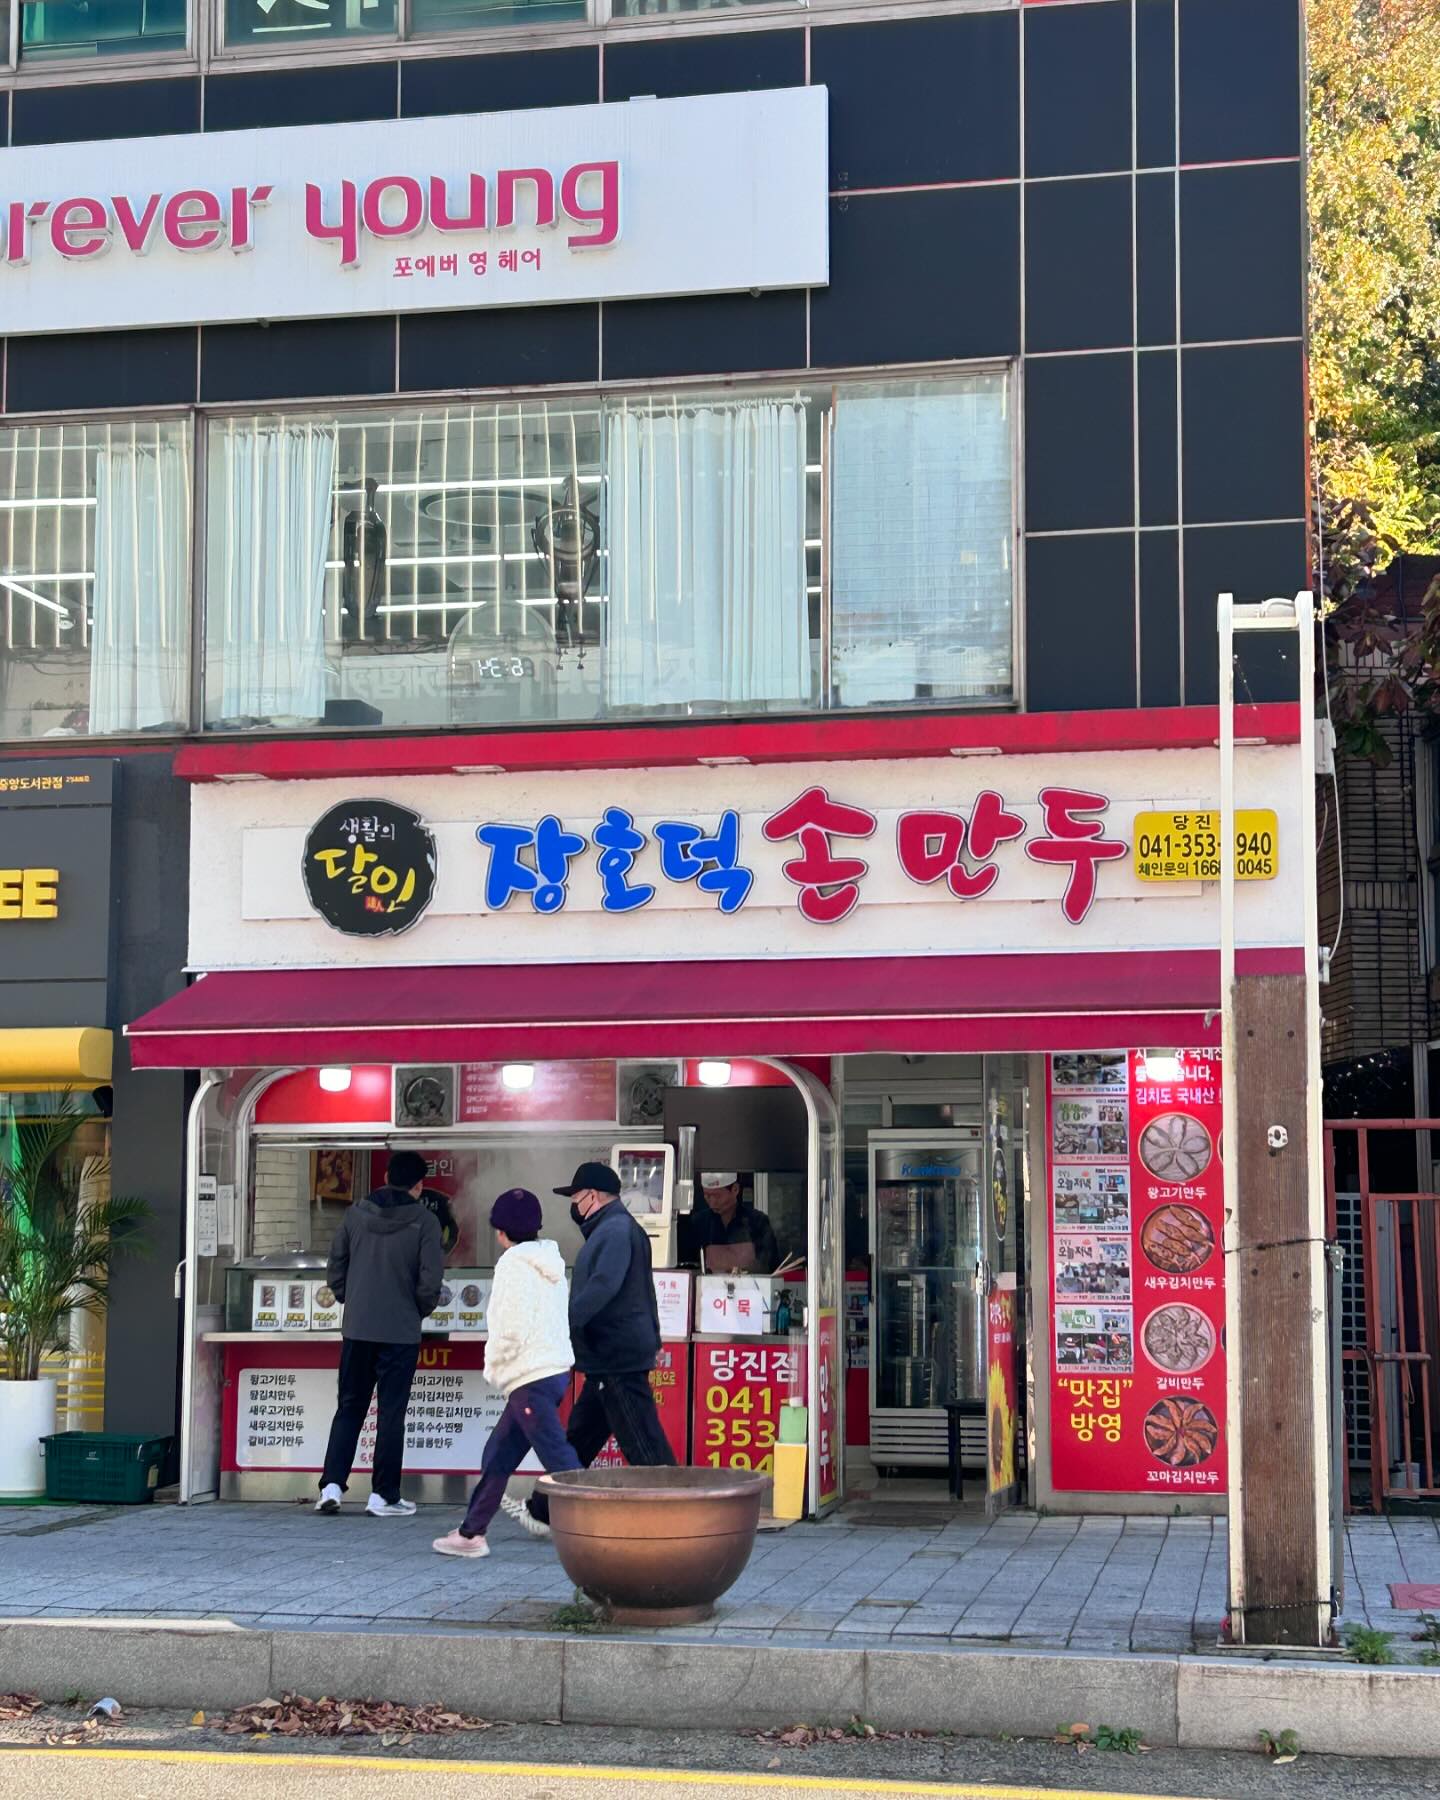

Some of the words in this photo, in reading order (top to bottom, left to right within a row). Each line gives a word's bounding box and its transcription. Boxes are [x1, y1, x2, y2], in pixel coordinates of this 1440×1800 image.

[0, 184, 273, 264] rever
[305, 160, 620, 267] young
[392, 254, 459, 278] 포에버
[468, 252, 489, 276] 영
[498, 247, 543, 274] 헤어
[339, 815, 396, 844] 생활의
[475, 806, 755, 914] 장호덕
[762, 785, 1129, 925] 손만두
[1139, 832, 1272, 859] 041-353-940
[313, 844, 416, 913] 달인
[1136, 1087, 1173, 1105] 김치도
[1177, 1087, 1215, 1106] 국내산
[1147, 1186, 1207, 1200] 왕고기만두
[1144, 1276, 1216, 1290] 새우김치만두
[710, 1349, 798, 1384] 당진점
[1156, 1376, 1205, 1391] 갈비만두
[249, 1405, 305, 1416] 새우고기만두
[705, 1386, 773, 1414] 041
[249, 1420, 305, 1431] 새우김치만두
[705, 1418, 776, 1448] 353
[1070, 1412, 1122, 1443] 방영
[707, 1451, 774, 1473] 194
[1146, 1469, 1219, 1484] 꼬마김치만두
